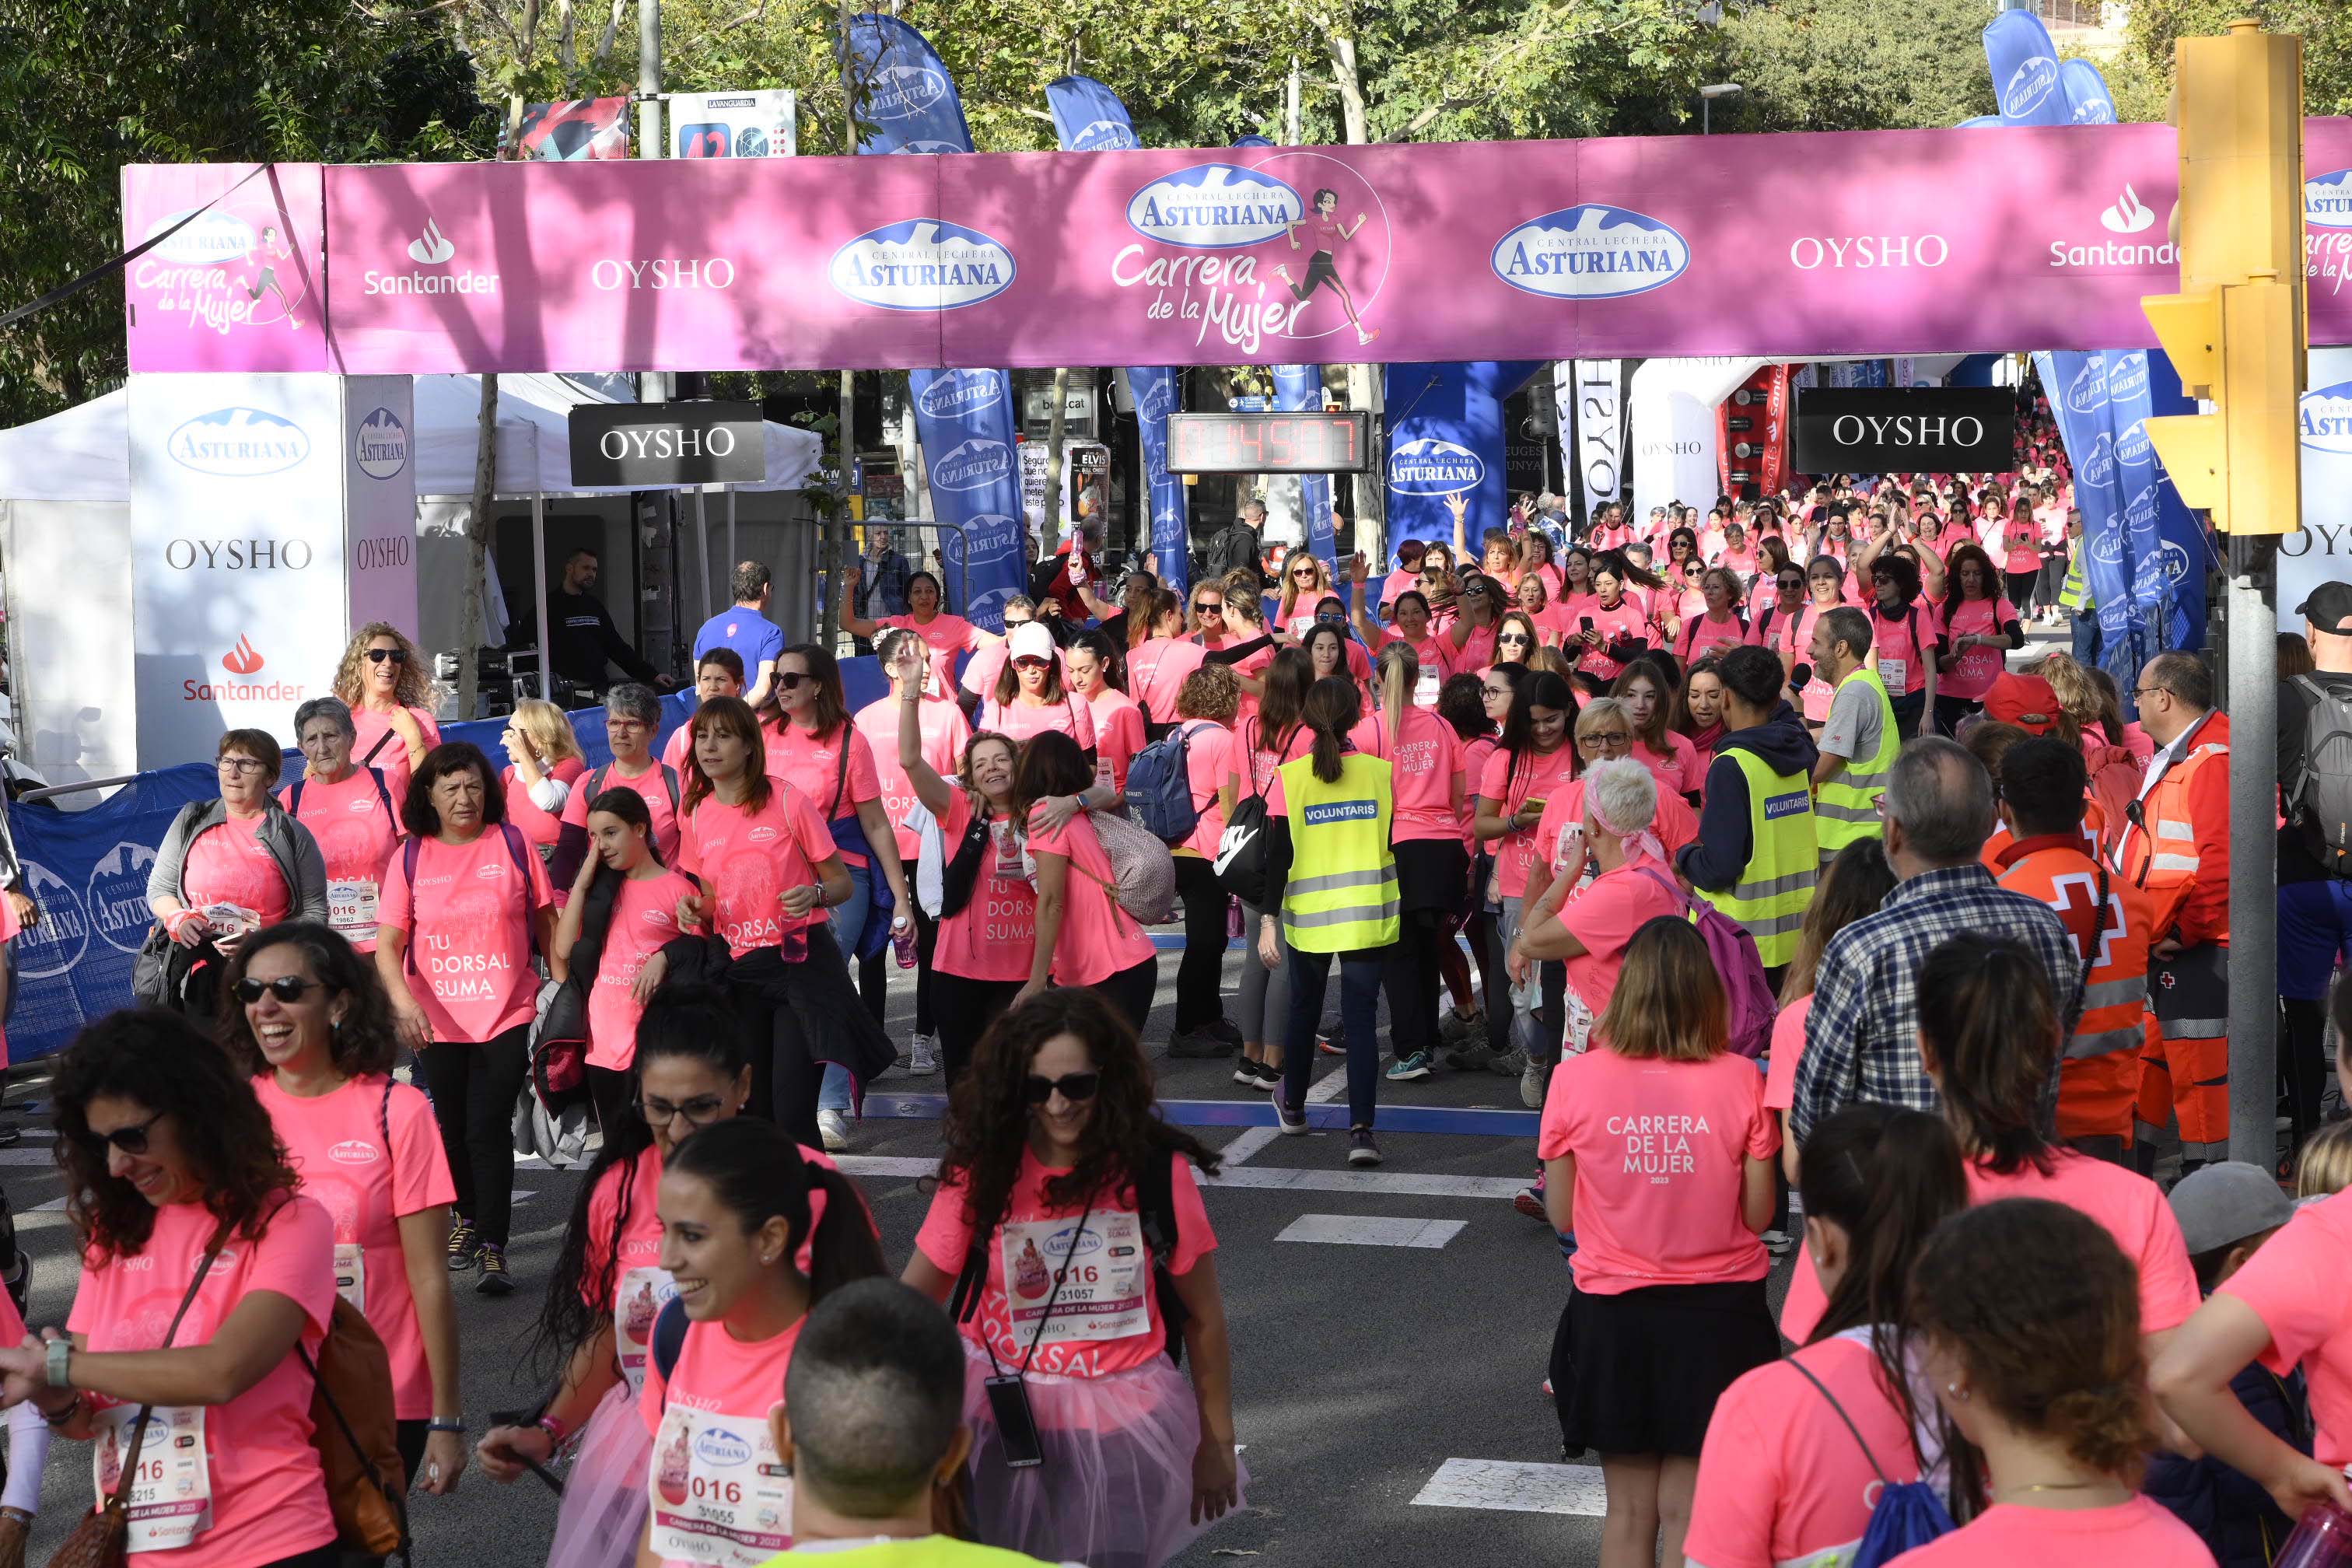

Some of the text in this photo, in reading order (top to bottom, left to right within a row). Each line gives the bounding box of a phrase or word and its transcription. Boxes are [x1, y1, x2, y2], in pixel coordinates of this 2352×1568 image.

[1166, 191, 1285, 201] CENTRAL LECHERA
[1140, 195, 1290, 227] ASTURIANA
[1537, 235, 1668, 247] CENTRAL LECHERA
[872, 248, 996, 261] CENTRAL LECHERA
[1507, 240, 1675, 276] ASTURIANA
[1790, 235, 1948, 269] OYSHO
[592, 257, 734, 290] OYSHO
[845, 254, 1002, 287] ASTURIANA
[1111, 243, 1257, 287] Carrera
[2322, 254, 2336, 277] la
[135, 260, 229, 289] Carrera
[365, 269, 499, 296] Santander
[158, 292, 191, 311] de la
[189, 286, 262, 335] Mujer
[1147, 289, 1199, 320] de la
[1196, 282, 1312, 355] Mujer
[1832, 414, 1984, 447] OYSHO
[180, 432, 299, 461] ASTURIANA
[359, 436, 404, 463] ASTURIANA
[600, 426, 735, 460] OYSHO
[1642, 441, 1702, 455] OYSHO
[1082, 454, 1106, 464] ELVIS
[1024, 467, 1037, 476] que
[1391, 462, 1478, 482] ASTURIANA
[1024, 478, 1048, 488] quiere
[166, 538, 312, 570] OYSHO
[358, 535, 408, 570] OYSHO
[1583, 659, 1615, 669] DORSAL
[1958, 654, 1993, 666] ORSAL
[1958, 667, 1984, 677] UMA
[184, 679, 304, 701] Santander
[1393, 740, 1439, 755] CARRERA
[1402, 751, 1432, 764] DE LA
[1402, 759, 1436, 773] MUJER
[300, 807, 327, 818] OYSHO
[1307, 803, 1375, 821] VOLUNTARIS
[1766, 796, 1809, 814] VOLUNTARIS
[418, 875, 451, 887] OYSHO
[987, 878, 1009, 894] TU
[190, 891, 212, 905] TU
[332, 905, 356, 915] 016
[985, 923, 1034, 940] SUMA
[425, 934, 450, 950] TU
[432, 952, 510, 973] DORSAL
[435, 977, 493, 996] SUMA
[1606, 1115, 1710, 1135] CARRERA
[334, 1147, 375, 1159] ASTURIANA
[1627, 1135, 1690, 1154] DE LA
[1623, 1155, 1695, 1174] MUJER
[1107, 1230, 1132, 1239] SUMA
[1053, 1265, 1099, 1285] 016
[1059, 1289, 1094, 1301] 31057
[1089, 1303, 1115, 1312] MUJER
[1097, 1317, 1138, 1330] Santander
[692, 1477, 741, 1503] 016
[130, 1509, 141, 1517] DE
[151, 1506, 175, 1515] MUJER
[705, 1524, 718, 1533] DE
